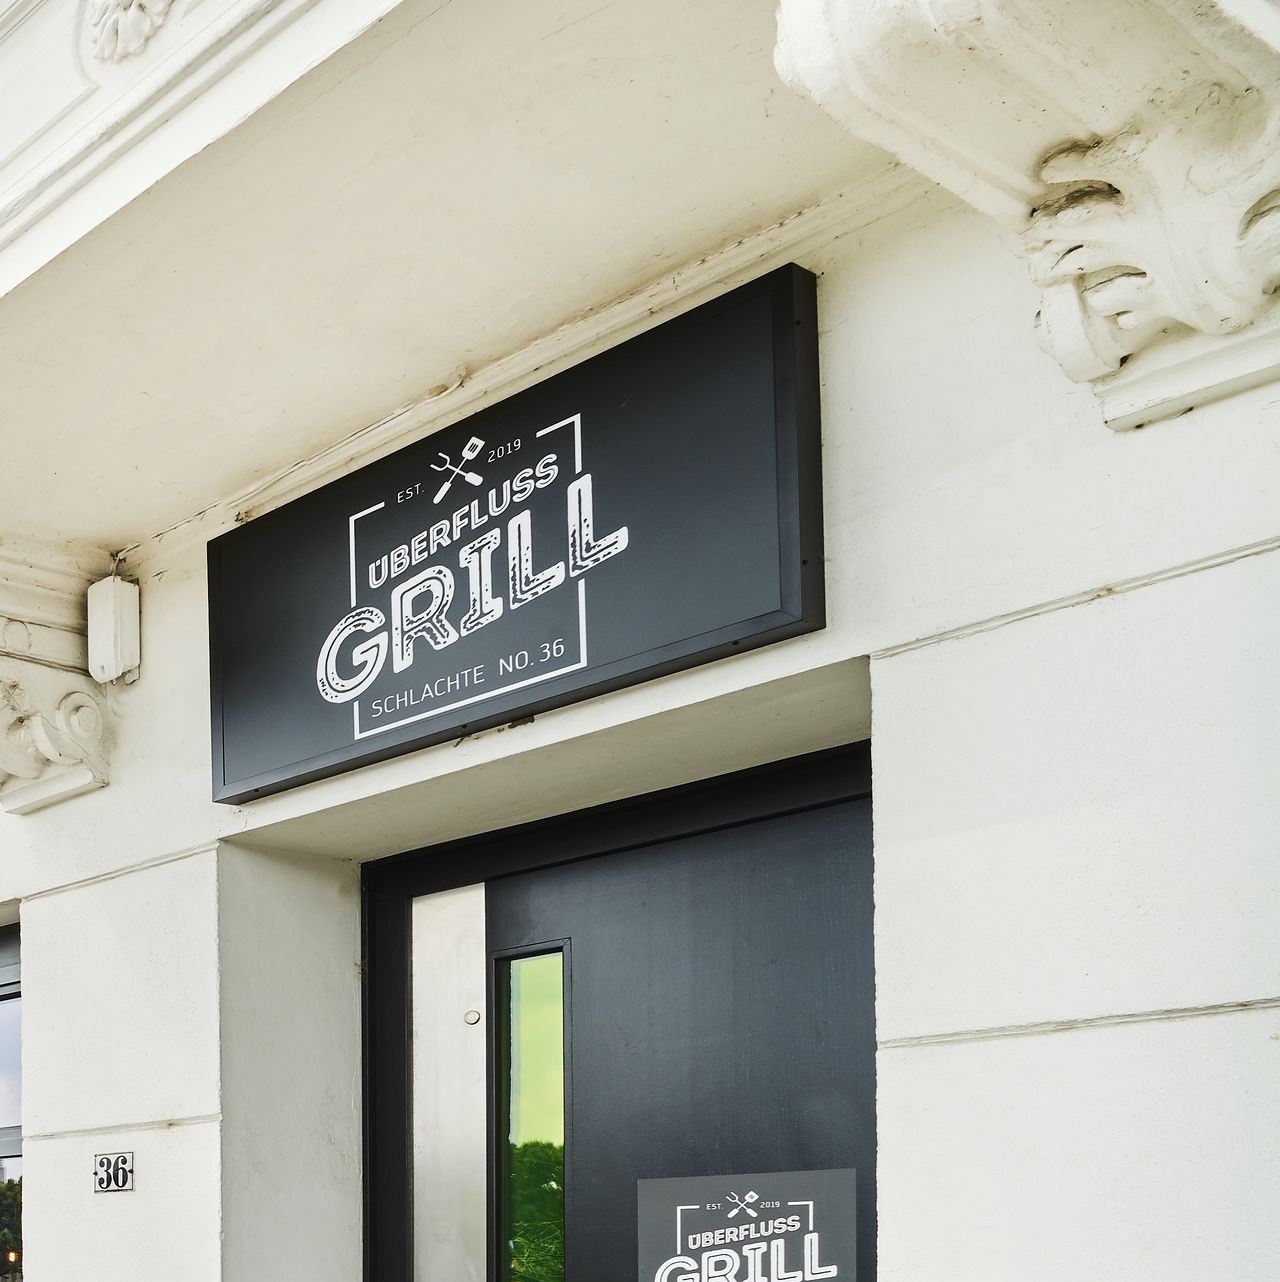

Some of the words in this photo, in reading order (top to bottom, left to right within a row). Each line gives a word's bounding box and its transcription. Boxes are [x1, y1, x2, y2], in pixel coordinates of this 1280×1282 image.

[396, 482, 425, 504] EST.
[486, 438, 522, 463] 2019
[367, 452, 559, 590] ÜBERFLUSS
[315, 473, 630, 704] GRILL
[371, 663, 485, 719] SCHLACHTE
[498, 651, 535, 674] NO.
[539, 637, 566, 662] 36
[98, 1155, 129, 1189] 36
[688, 1215, 801, 1250] ÜBERFLUSS
[706, 1203, 723, 1211] EST.
[760, 1201, 780, 1209] 2019
